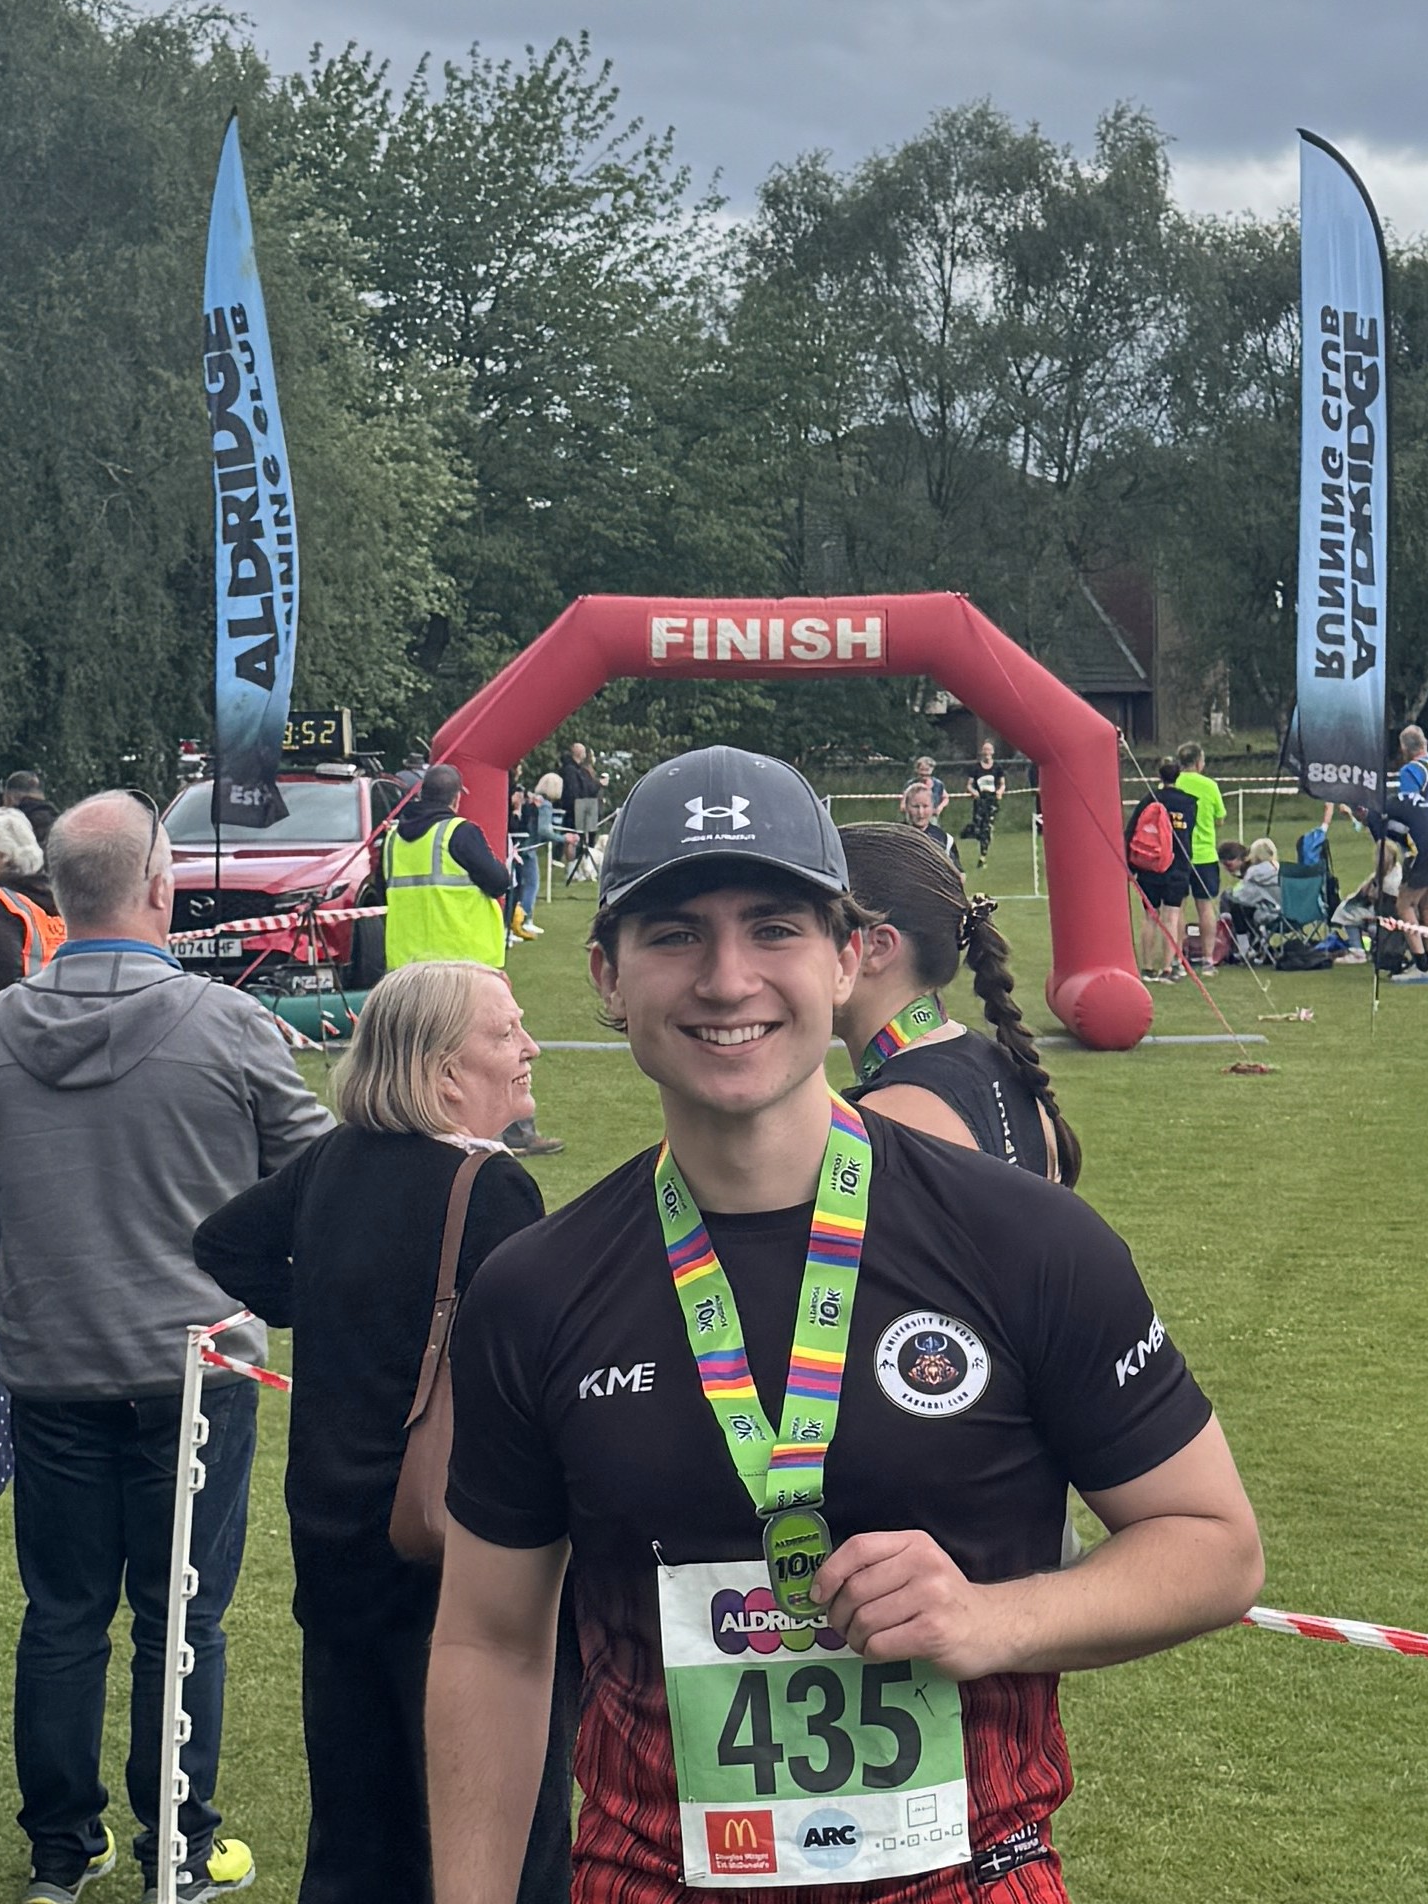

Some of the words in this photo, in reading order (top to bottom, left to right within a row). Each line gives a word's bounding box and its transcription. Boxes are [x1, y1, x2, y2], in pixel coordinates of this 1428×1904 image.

[203, 307, 279, 691] ALDRIDGE
[651, 617, 882, 660] FINISH
[840, 1157, 862, 1196] 10K
[694, 1298, 716, 1334] 10K
[819, 1288, 842, 1327] 10K
[578, 1362, 656, 1400] KME
[727, 1412, 754, 1444] 10K
[797, 1417, 824, 1441] 0K
[719, 1610, 833, 1634] ALDRIDG
[717, 1659, 922, 1795] 435
[803, 1825, 857, 1848] ARC
